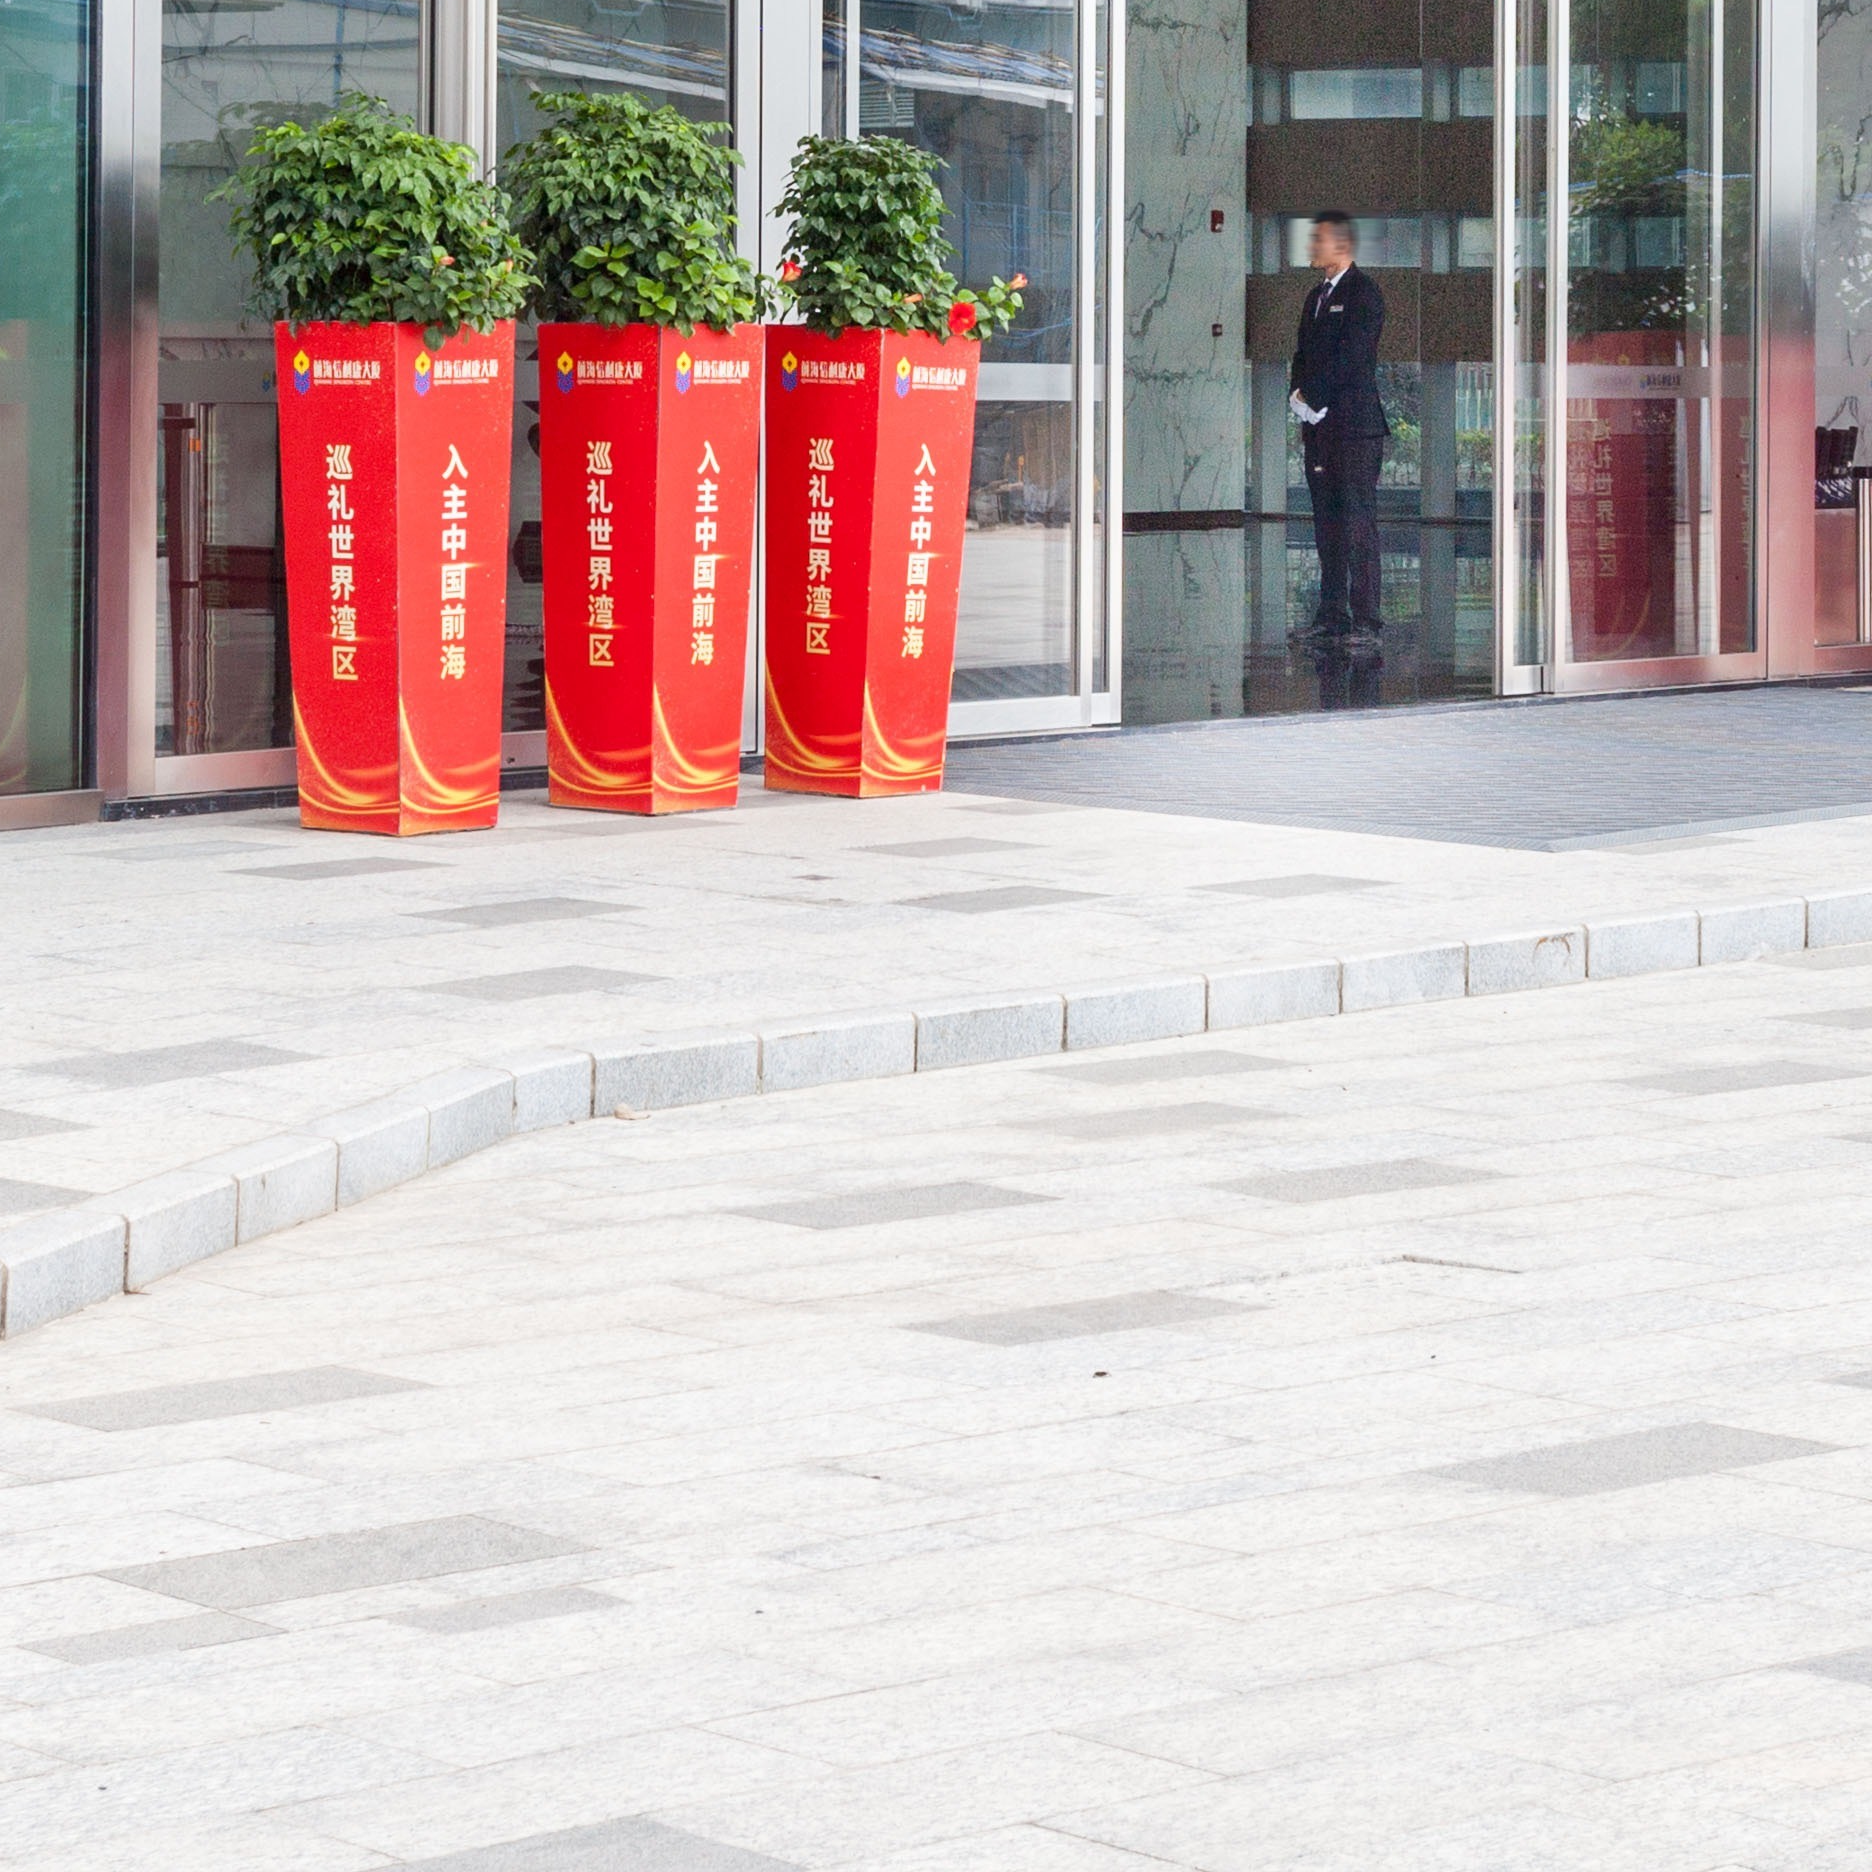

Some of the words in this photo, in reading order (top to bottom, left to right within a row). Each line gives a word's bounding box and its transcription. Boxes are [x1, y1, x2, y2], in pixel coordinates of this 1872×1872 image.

[326, 443, 359, 681] 巡礼世界湾区
[440, 444, 468, 680] 入主中国前海
[586, 440, 615, 667] 巡礼世界湾区
[690, 440, 722, 666] 入主中国前海
[806, 437, 836, 655] 巡礼世界湾区
[901, 443, 936, 659] 入主中国前海
